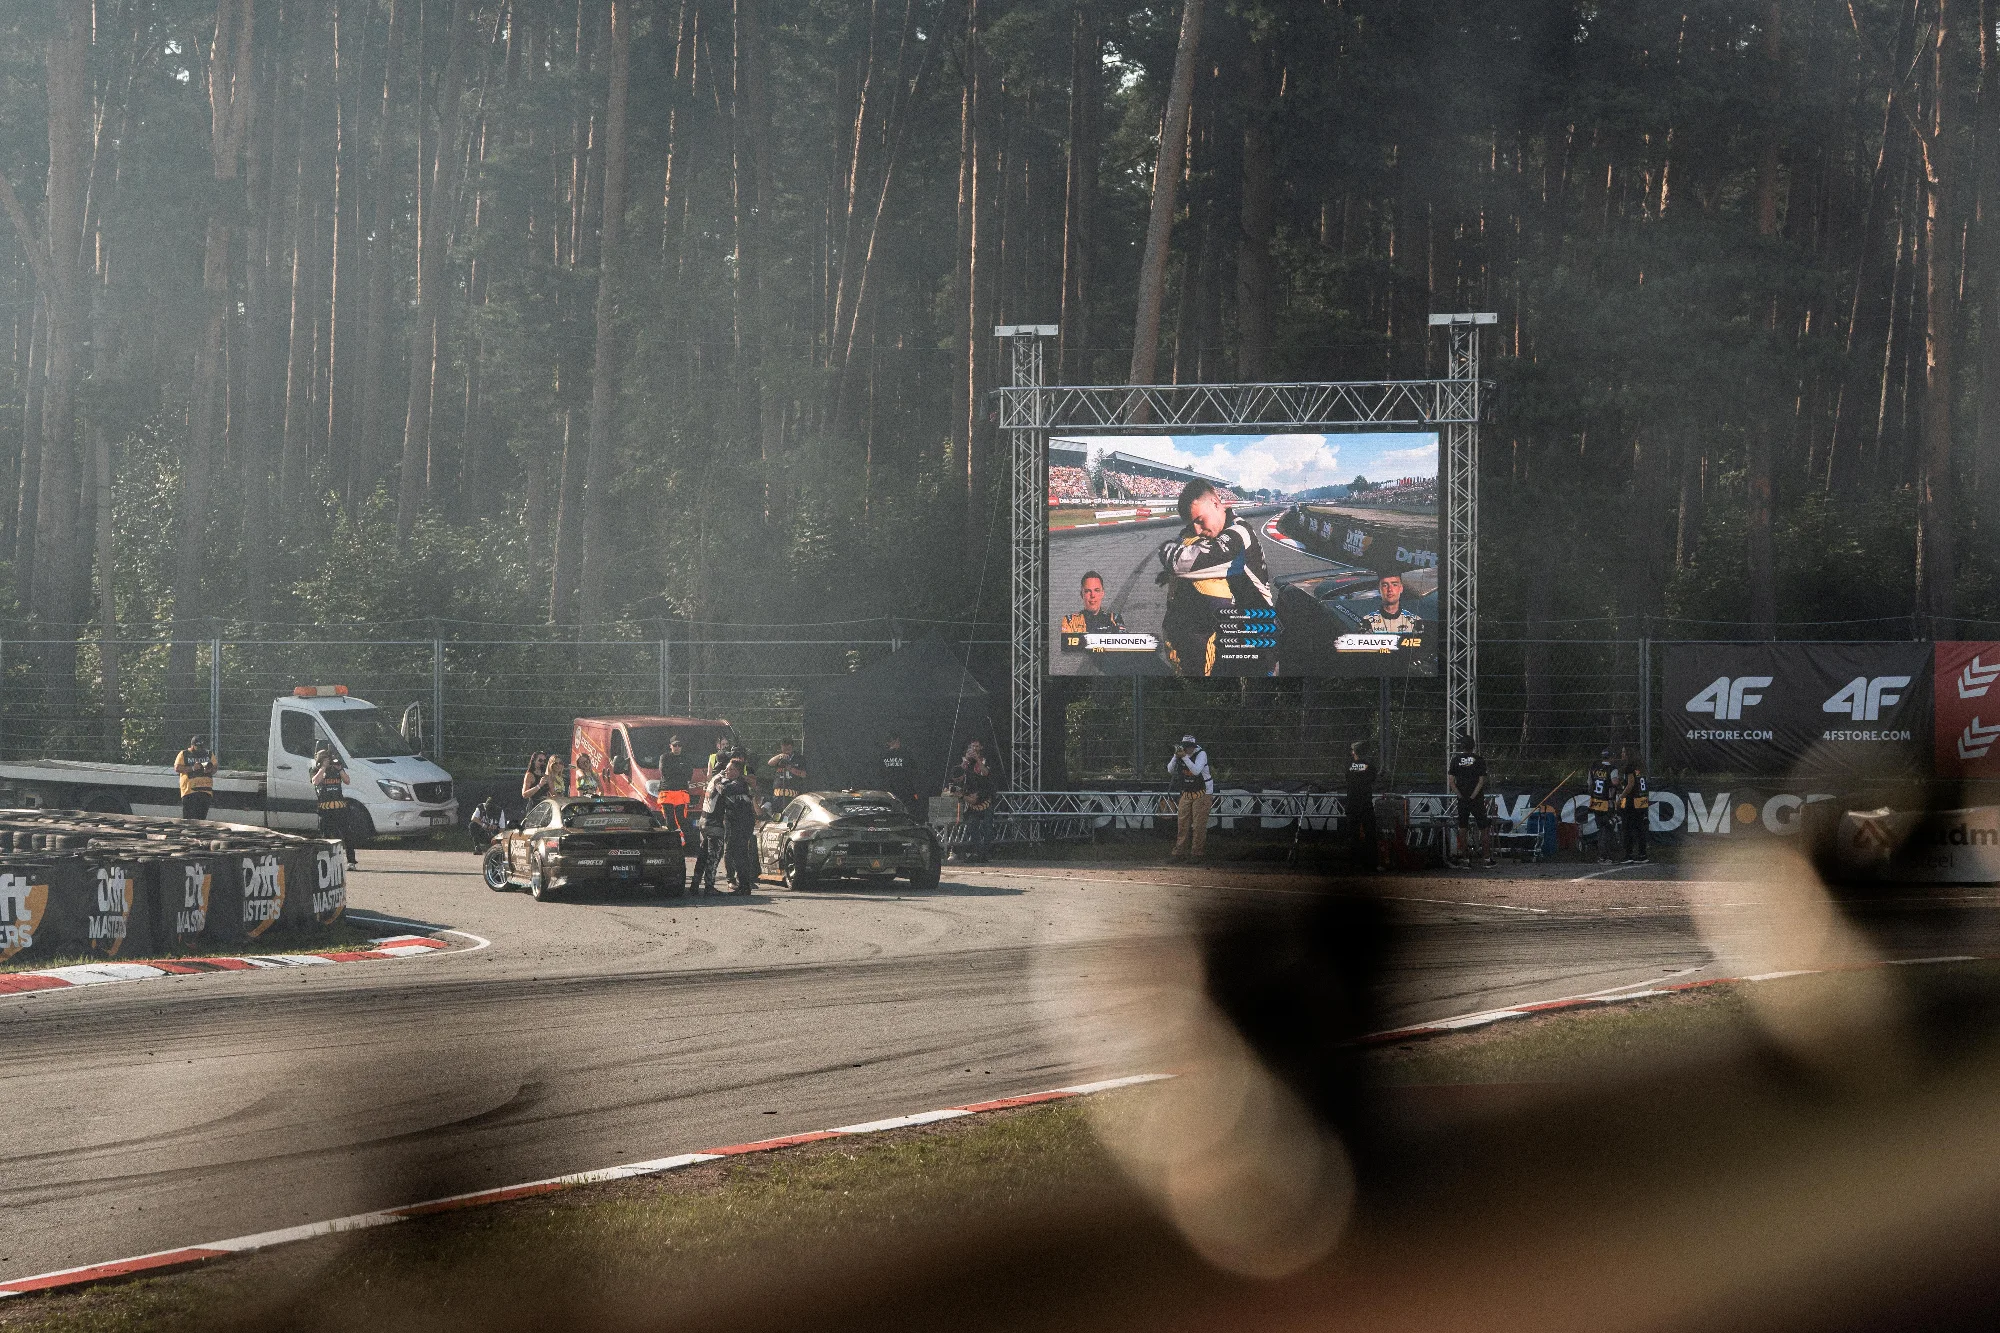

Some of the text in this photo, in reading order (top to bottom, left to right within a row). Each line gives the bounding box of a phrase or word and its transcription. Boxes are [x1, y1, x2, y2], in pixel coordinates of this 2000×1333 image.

[1396, 546, 1438, 568] Drift
[1067, 637, 1079, 645] 18
[1401, 638, 1422, 647] 412
[1685, 676, 1774, 720] 4F
[1822, 676, 1912, 720] 4F
[1686, 729, 1773, 741] 4FSTORE.COM
[1822, 729, 1911, 741] 4FSTORE.COM
[580, 736, 603, 763] RESCUE
[1639, 777, 1646, 791] 8
[242, 854, 281, 898] Drift
